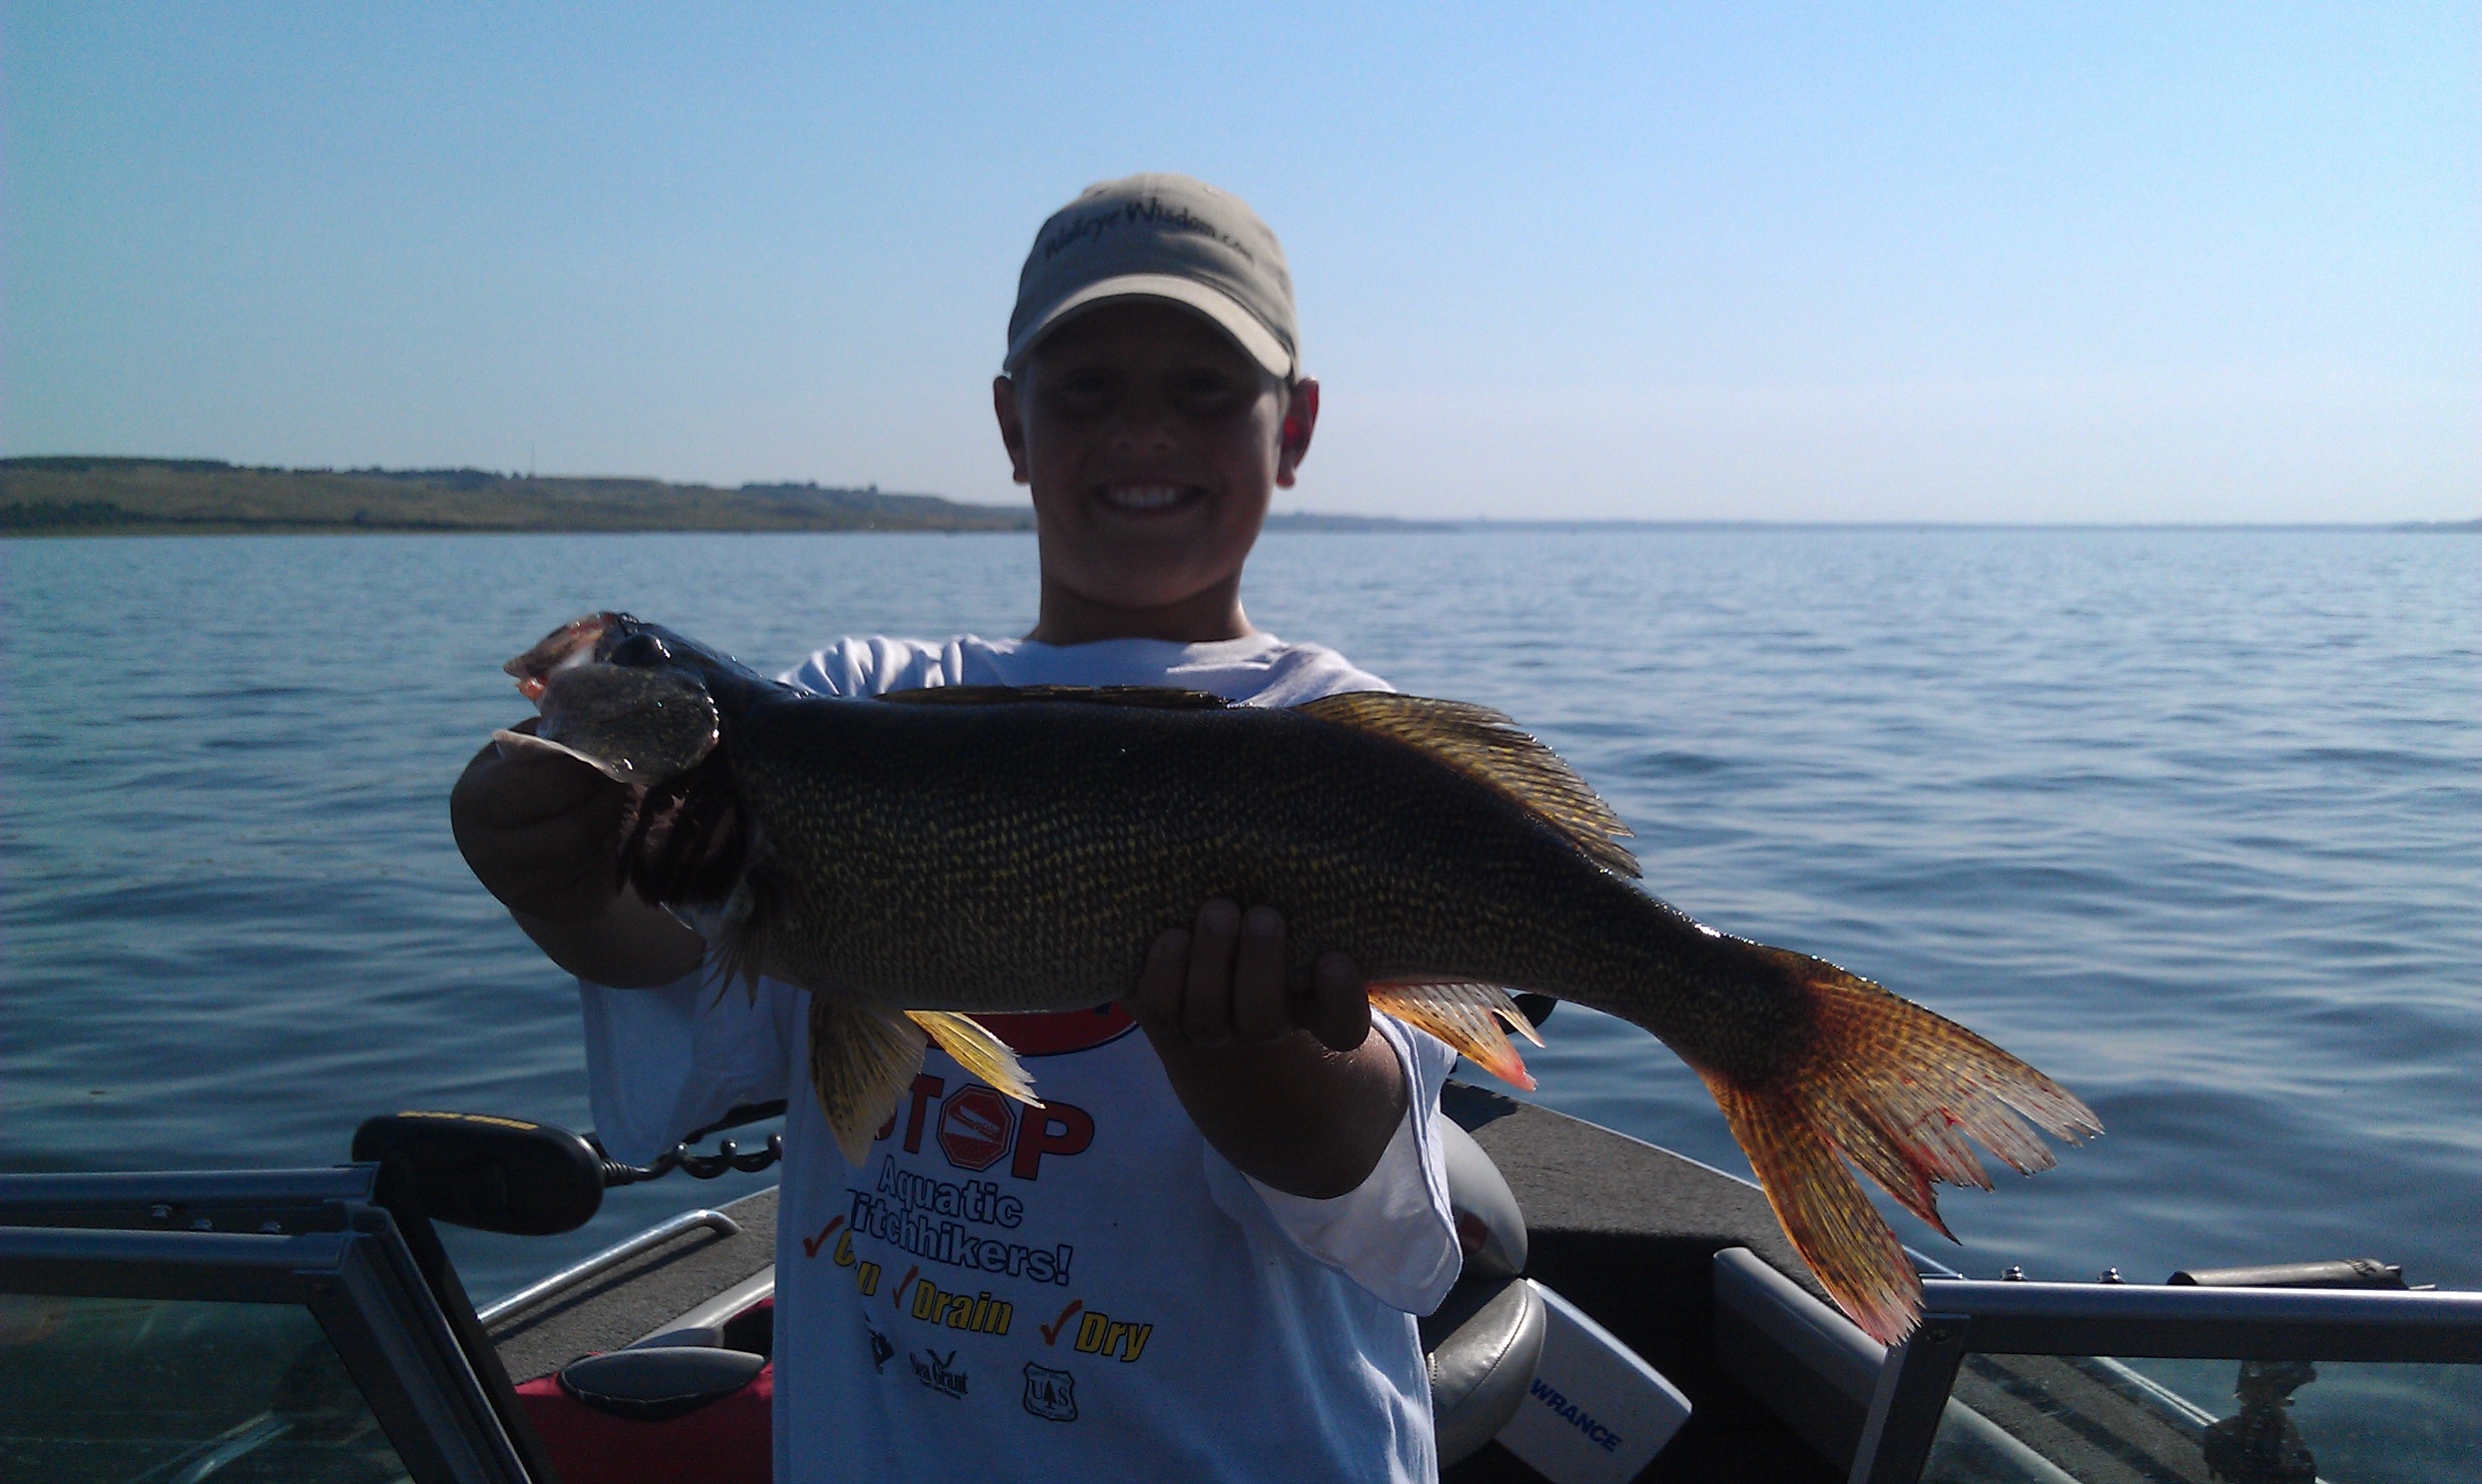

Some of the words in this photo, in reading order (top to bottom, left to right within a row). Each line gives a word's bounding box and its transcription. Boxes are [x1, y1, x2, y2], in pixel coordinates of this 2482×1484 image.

[875, 1073, 1095, 1181] TOP
[878, 1154, 1024, 1229] Aquatic
[912, 1277, 1014, 1336] Drain
[1074, 1311, 1154, 1363] Dry
[1528, 1377, 1623, 1454] WRANCE
